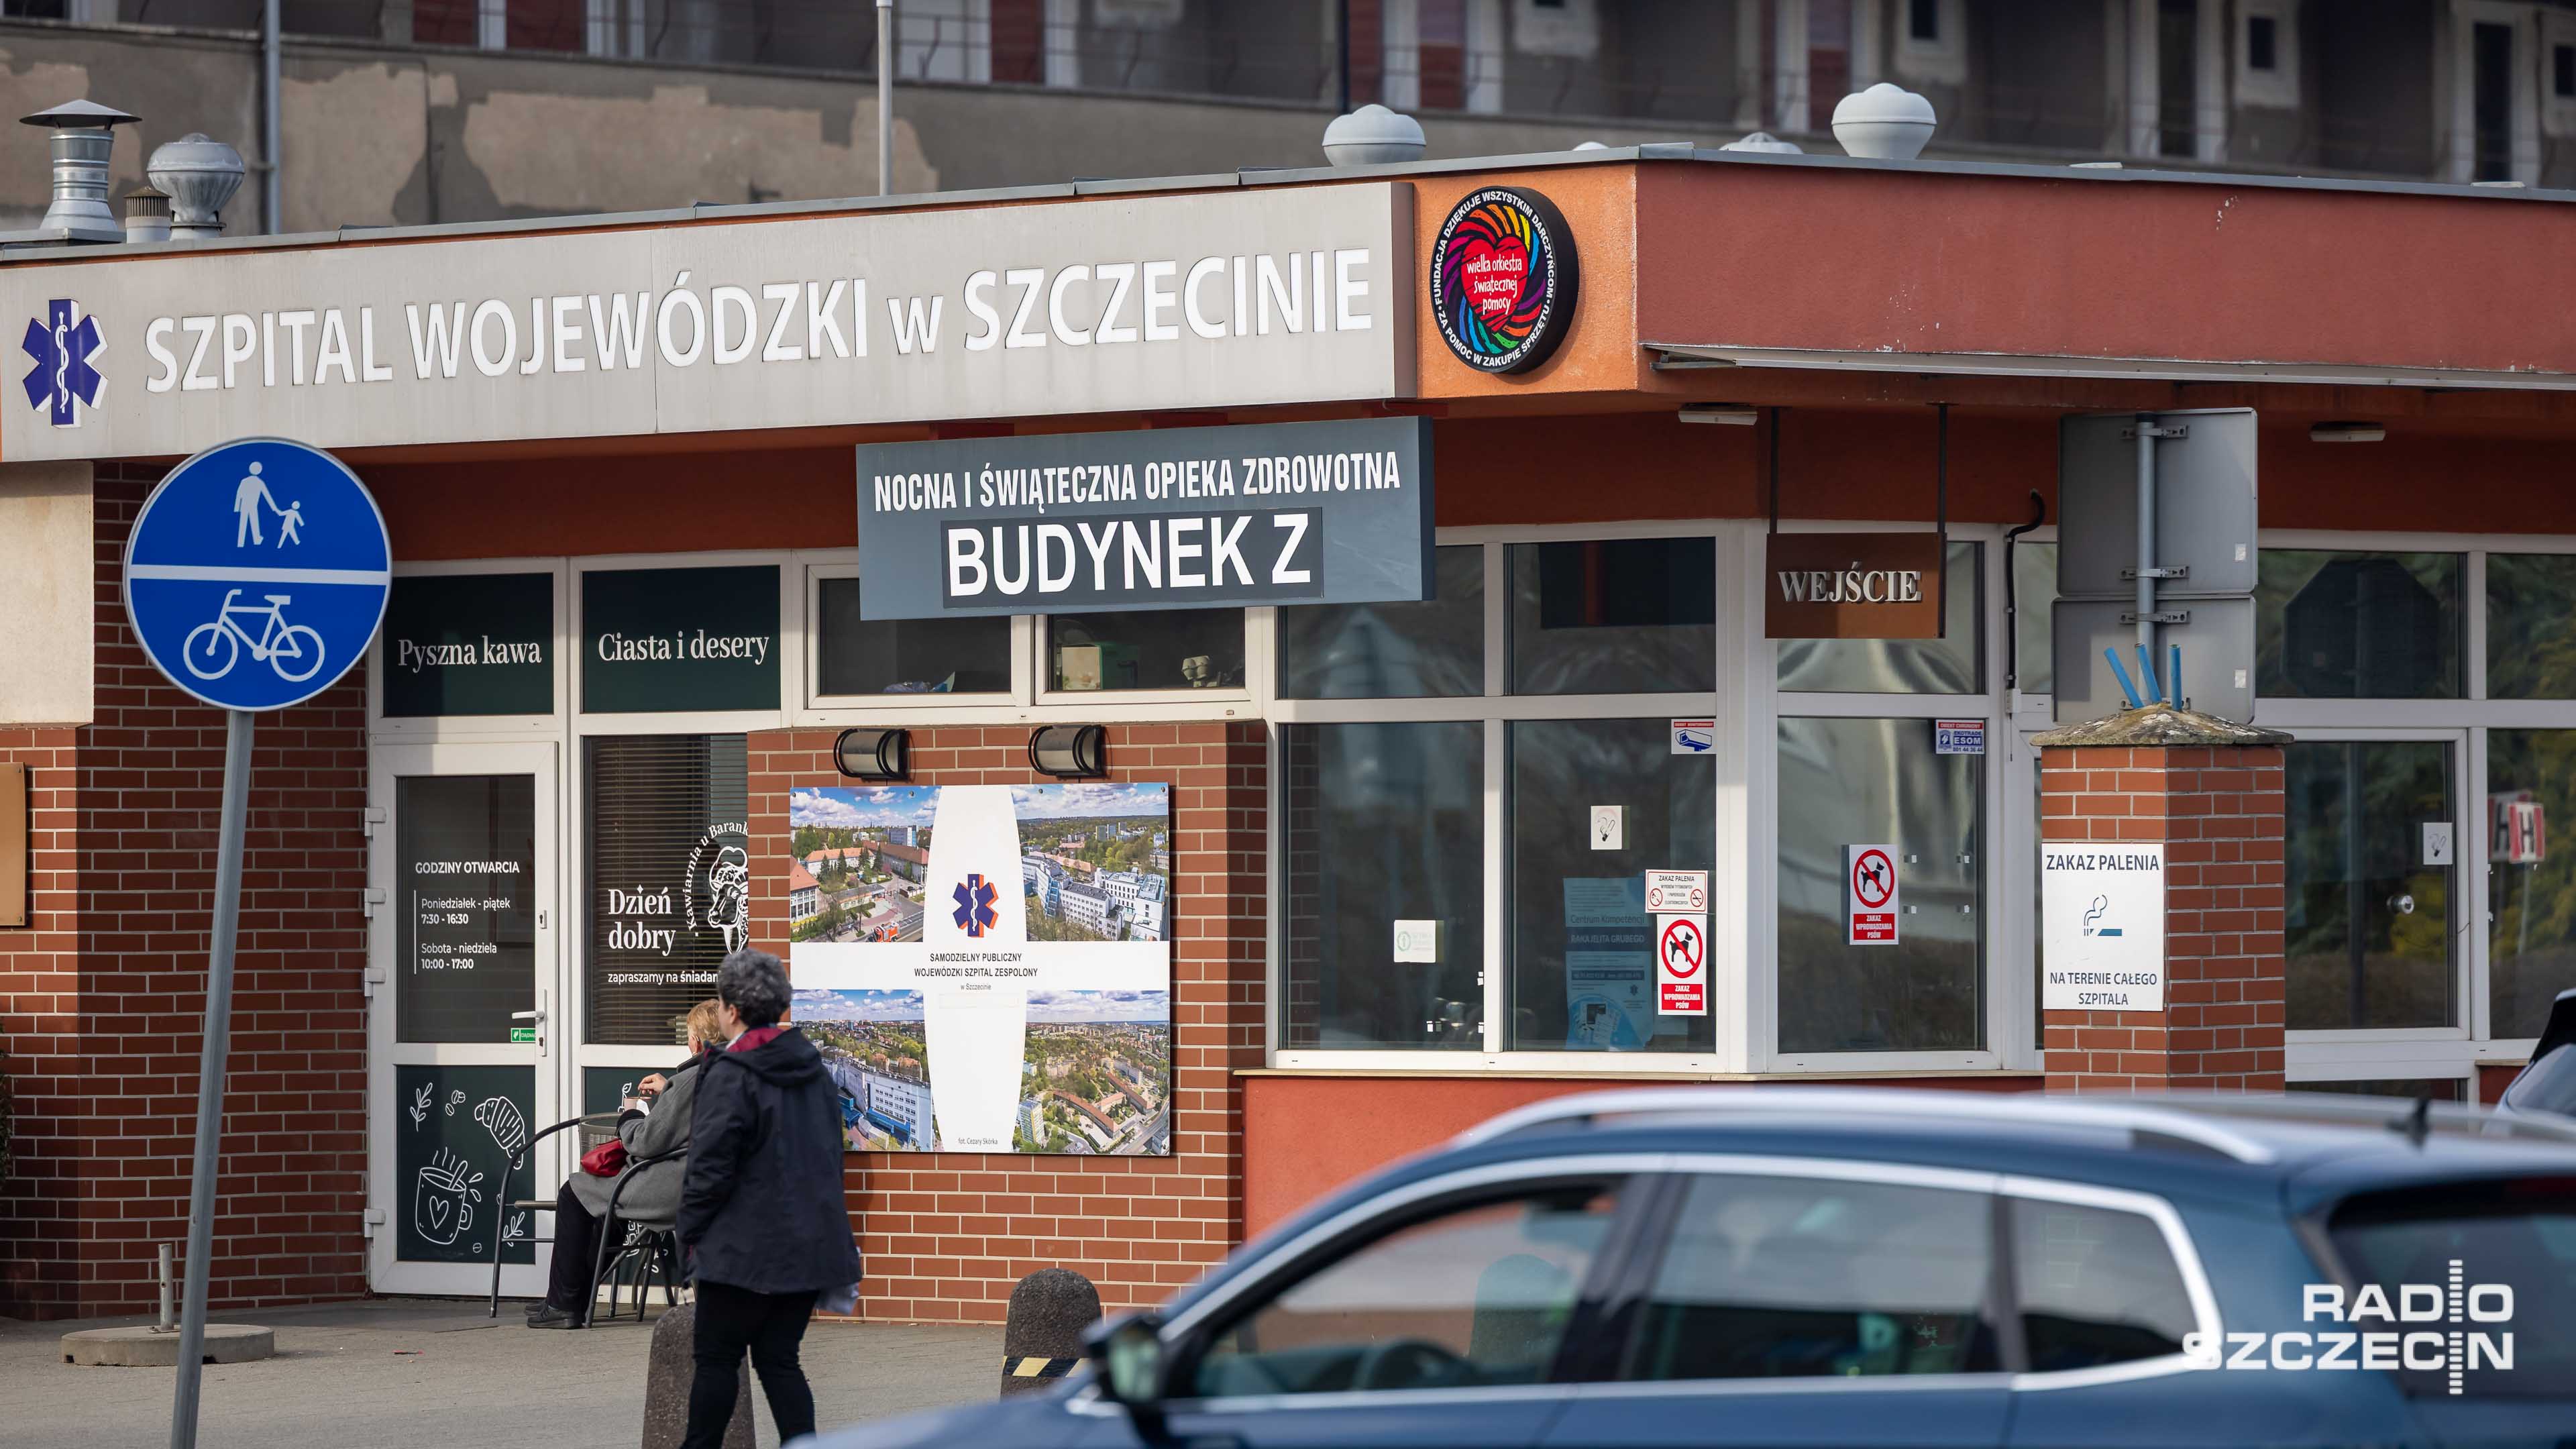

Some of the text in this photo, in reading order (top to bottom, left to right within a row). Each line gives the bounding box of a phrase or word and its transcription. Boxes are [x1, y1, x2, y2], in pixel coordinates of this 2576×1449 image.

[1433, 191, 1554, 305] FUNDACJA DZIĘKUJE WSZYSTKIM DARCZYŃCOM
[1466, 254, 1522, 273] wielka orkiestra
[1473, 275, 1517, 297] świątecznej
[1483, 297, 1511, 315] pomocy
[146, 247, 1372, 393] SZPITAL WOJEWÓDZKI w SZCZECINIE
[1438, 305, 1550, 366] ZA POMOC W ZAKUPIE SPRZĘTU
[874, 451, 1401, 514] NOCNA I ŚWIĄTECZNA OPIEKA ZDROWOTNA
[947, 513, 1311, 597] BUDYNEK Z
[1778, 561, 1922, 602] WEJŚCIE
[398, 635, 542, 674] Pyszna kawa
[598, 629, 769, 665] Ciasta i desery
[415, 861, 520, 874] GODZINY OTWARCIA
[2046, 855, 2159, 871] ZAKAZ PALENIA
[683, 820, 749, 931] Kawiarnia u Barank
[421, 898, 476, 909] Poniedziałek
[483, 897, 511, 911] piątek
[608, 884, 672, 915] Dzień
[421, 914, 439, 924] 7:30
[447, 914, 469, 924] 16:30
[1571, 914, 1600, 924] Centrum
[421, 943, 451, 954] Sobota
[459, 942, 497, 954] niedziela
[608, 921, 676, 957] dobry
[421, 959, 444, 969] 10:00
[451, 958, 474, 969] 17:00
[930, 953, 1022, 962] SAMODZIELNY PUBLICZNY
[608, 971, 719, 985] zapraszamy na śniadan
[914, 966, 1038, 977] WOJEWÓDZKI SZPITAL ZESPOLONY
[2050, 973, 2157, 985] NA TERENIE CAŁEGO
[1676, 1000, 1689, 1009] PSÓW
[2078, 993, 2129, 1005] SZPITALA
